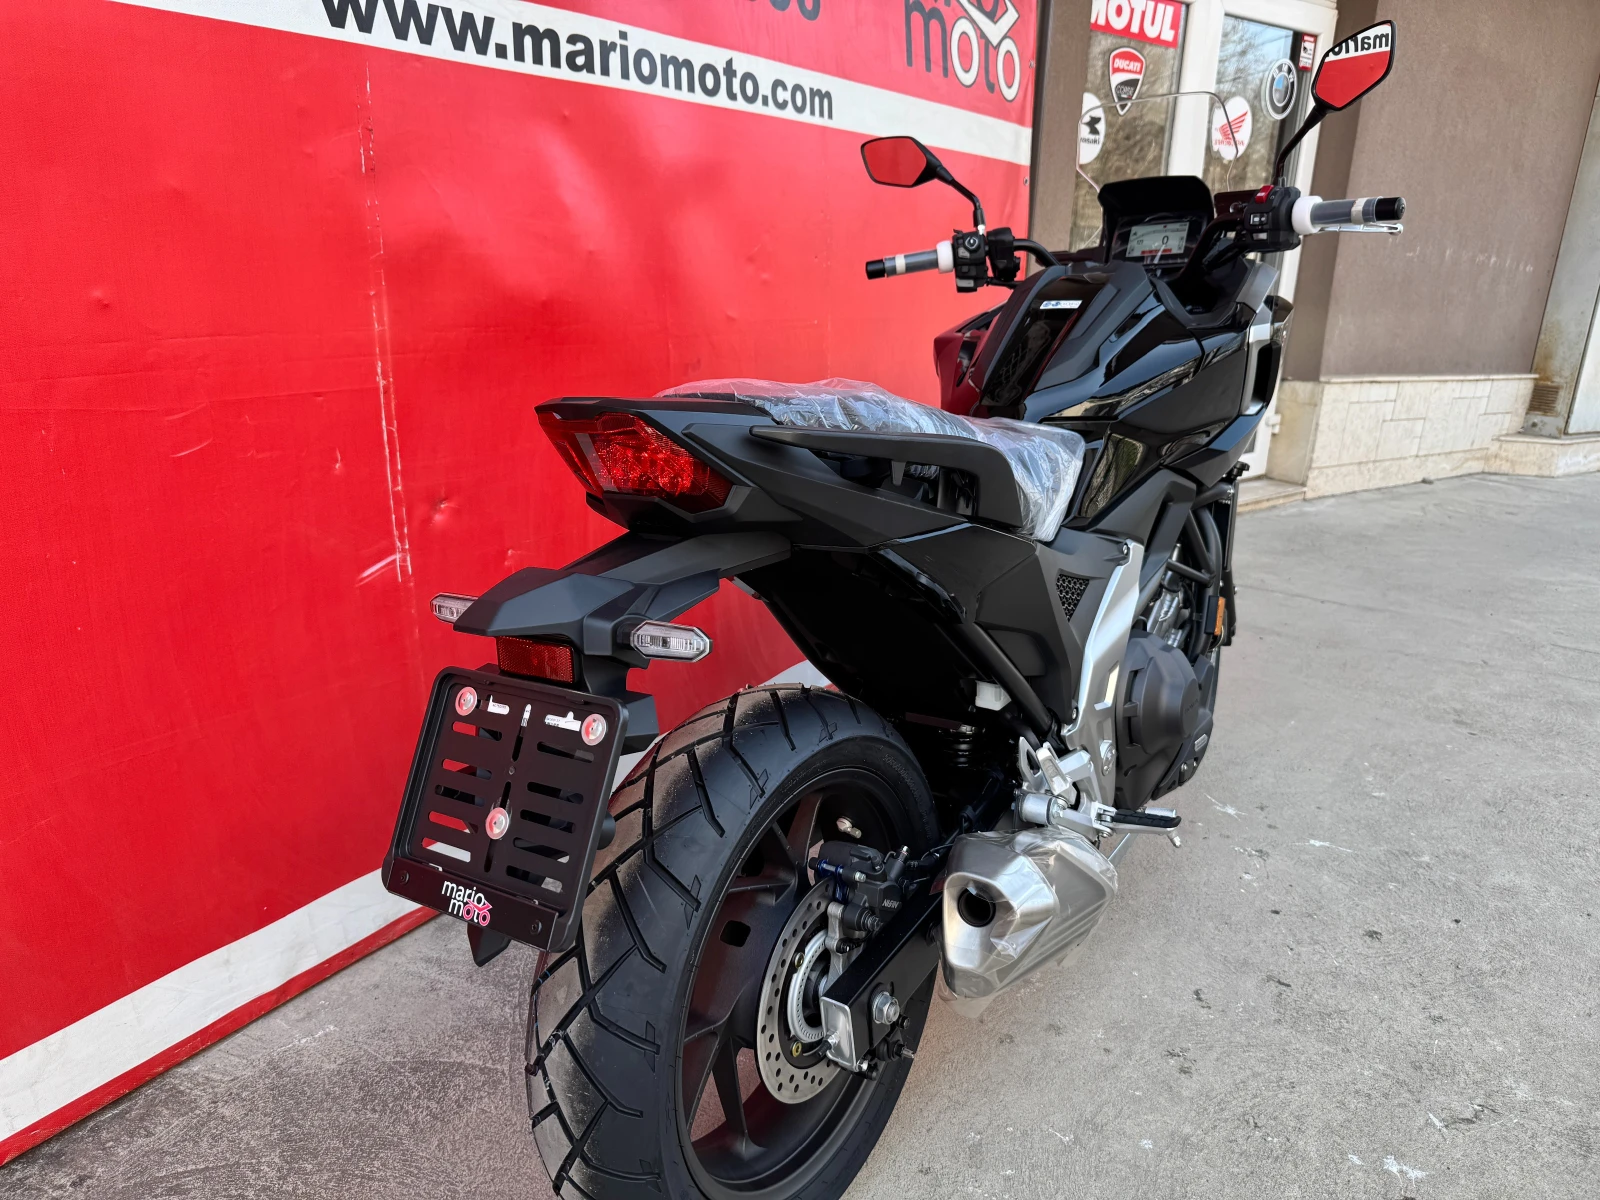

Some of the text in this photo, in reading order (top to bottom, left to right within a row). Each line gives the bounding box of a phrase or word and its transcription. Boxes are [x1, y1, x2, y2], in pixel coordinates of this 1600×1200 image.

[321, 0, 834, 120] www.mariomoto.com
[904, 0, 1021, 102] moto
[1113, 58, 1142, 72] DUCATI
[441, 880, 485, 906] mario
[448, 899, 491, 927] moto
